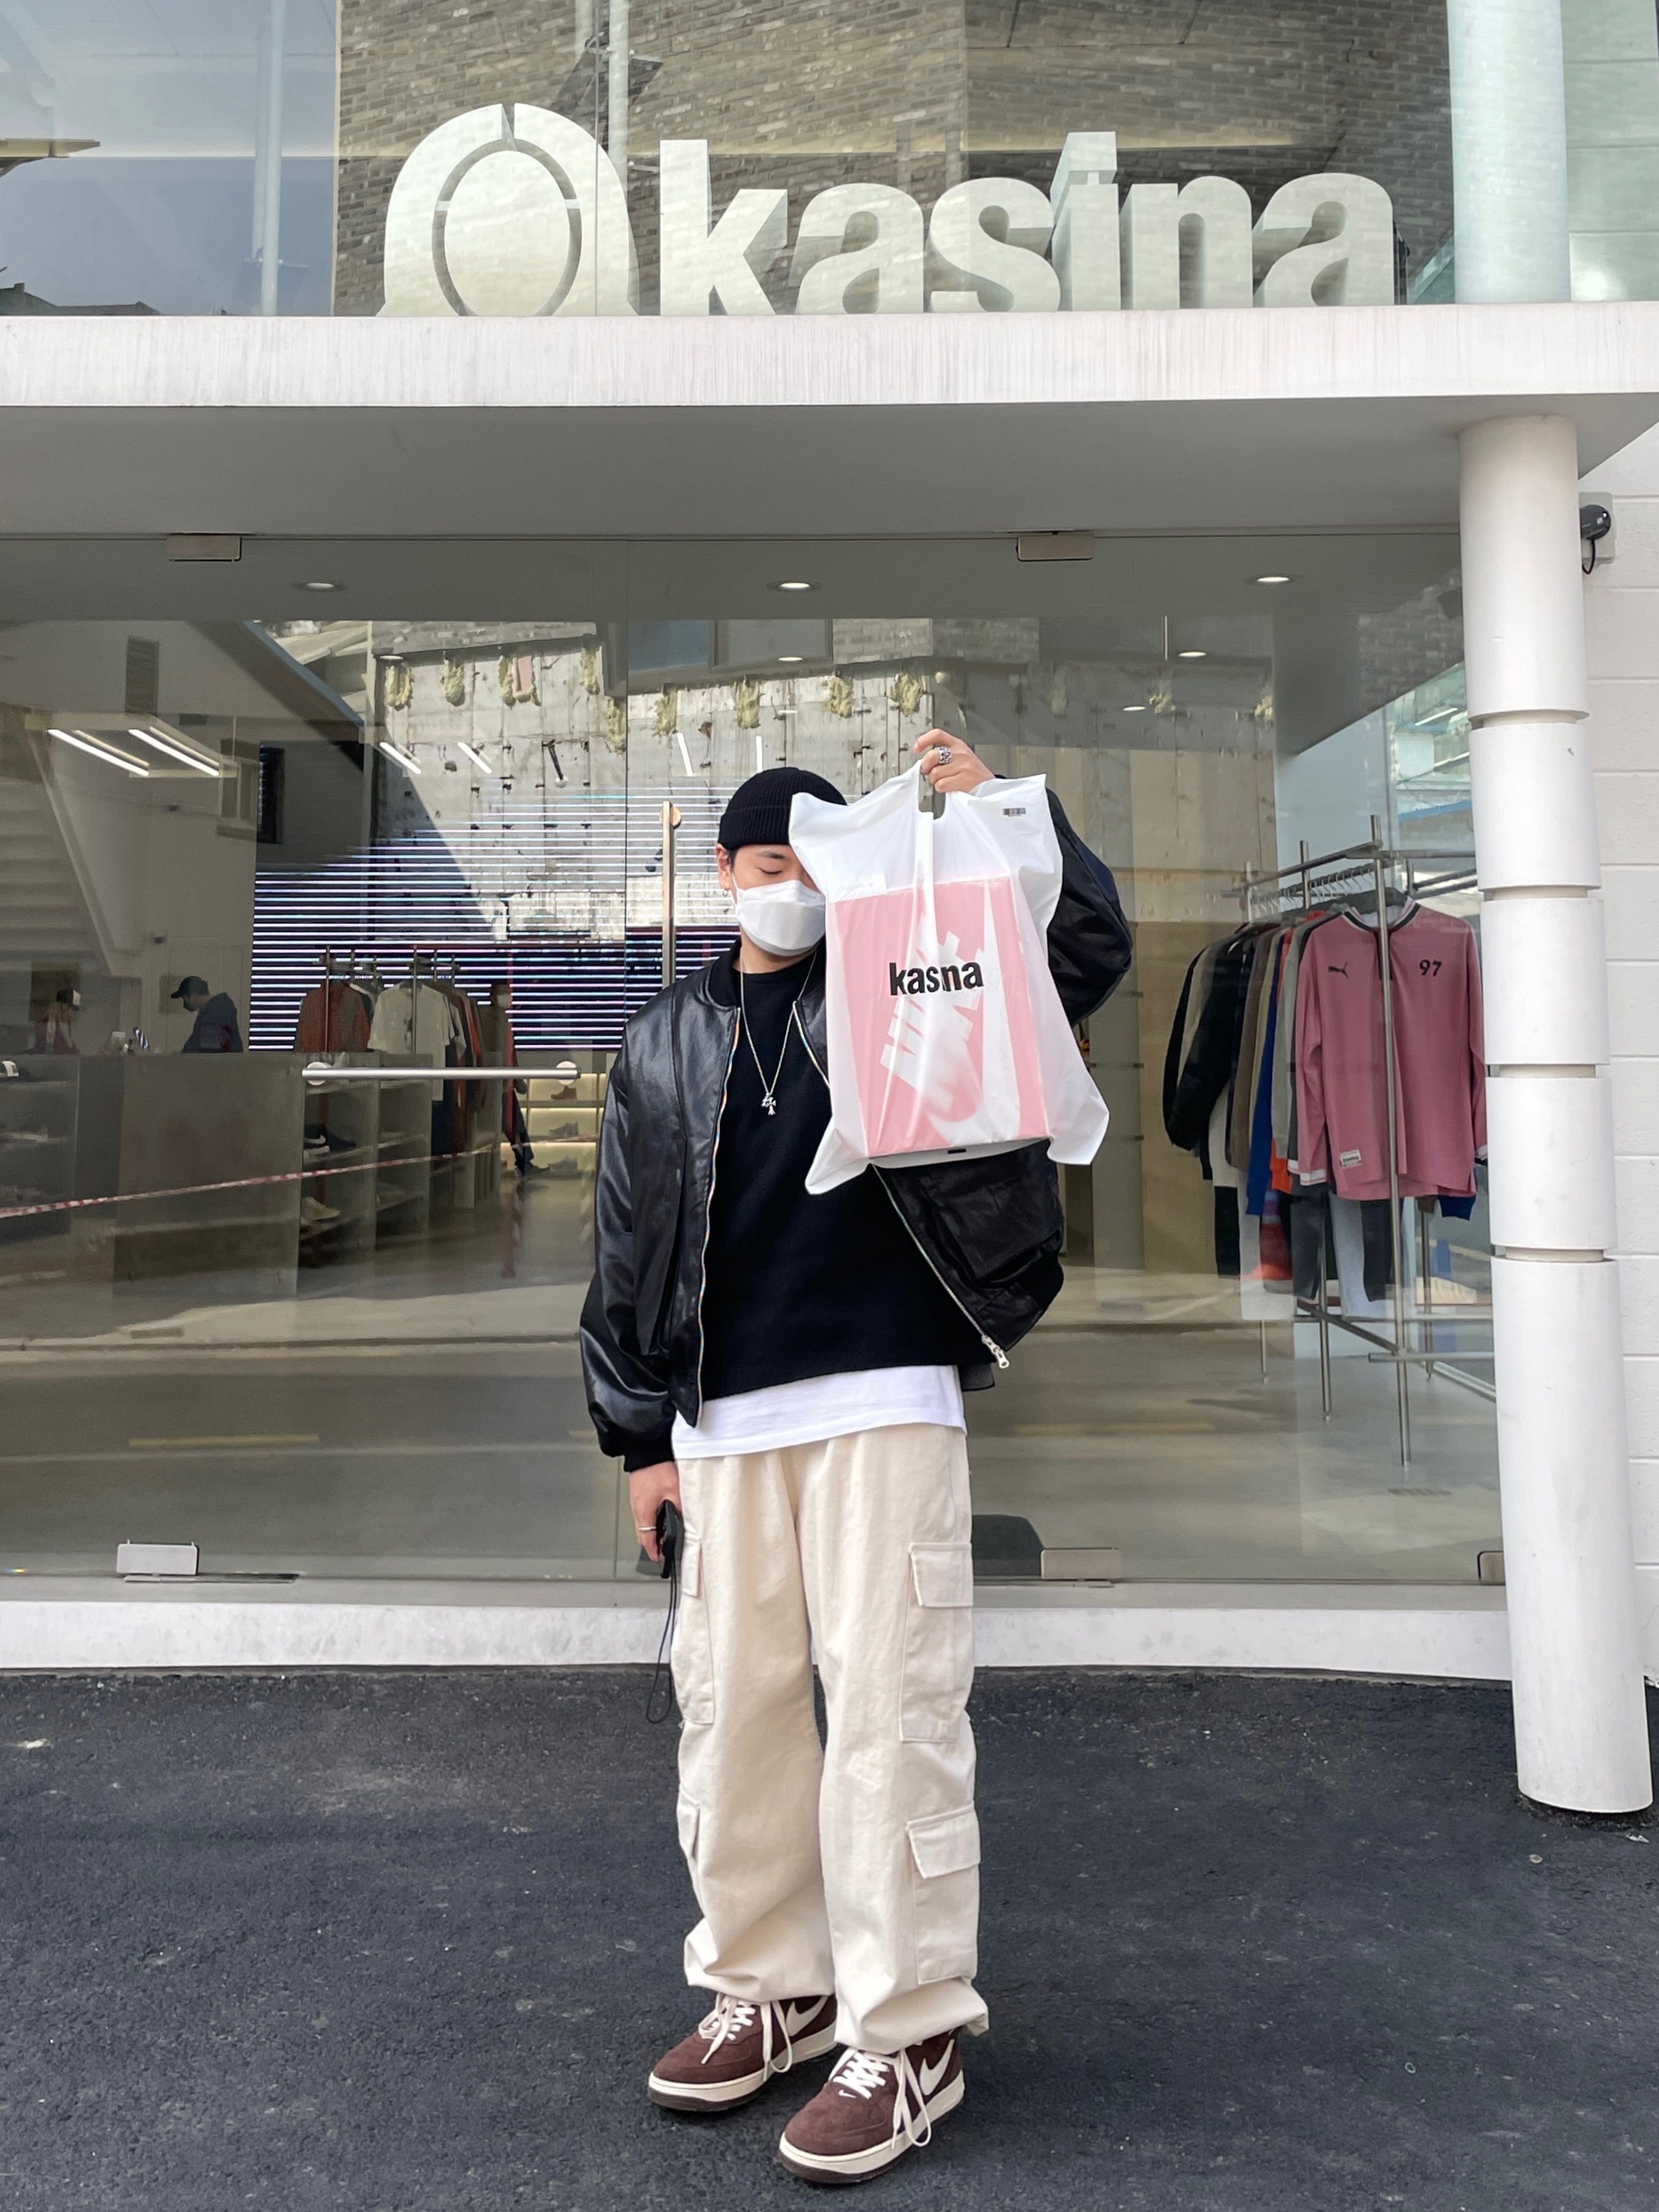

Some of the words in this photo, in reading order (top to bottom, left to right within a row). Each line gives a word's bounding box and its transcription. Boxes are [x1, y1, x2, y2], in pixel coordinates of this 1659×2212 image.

[660, 131, 1395, 316] kasina
[889, 962, 984, 995] kasna
[1419, 959, 1443, 977] 97
